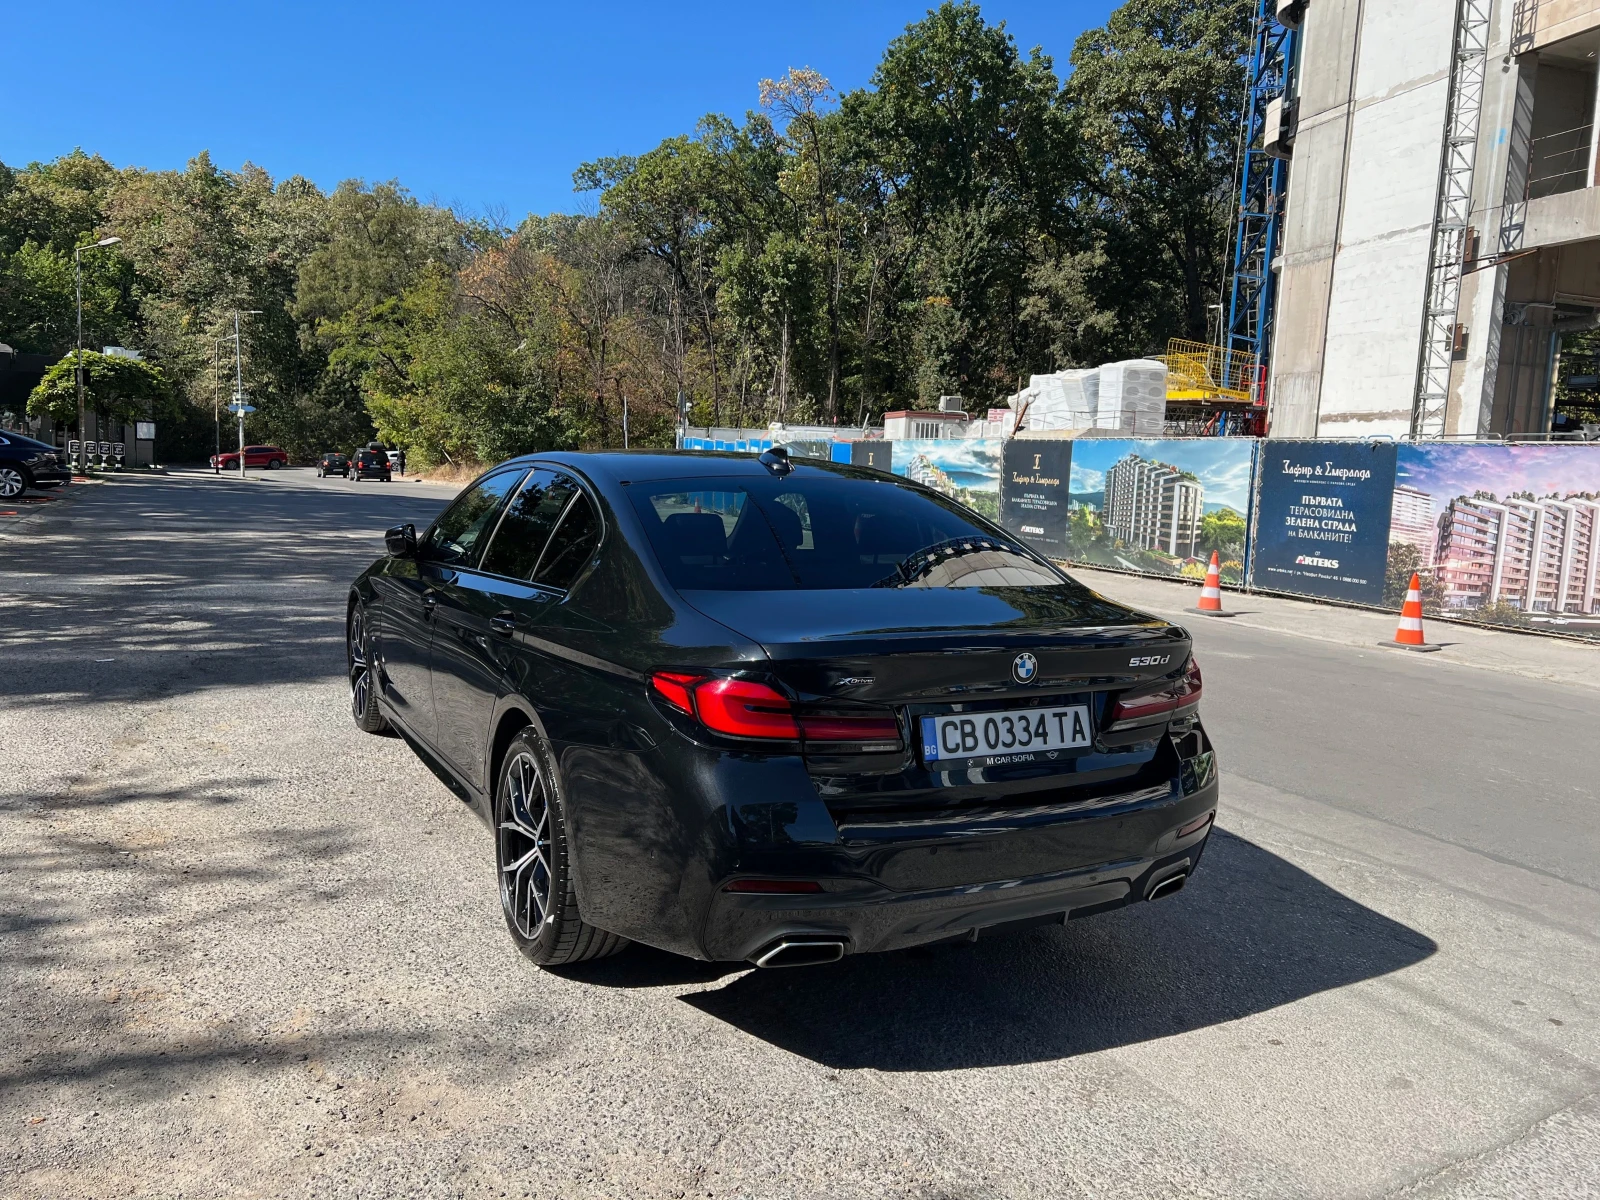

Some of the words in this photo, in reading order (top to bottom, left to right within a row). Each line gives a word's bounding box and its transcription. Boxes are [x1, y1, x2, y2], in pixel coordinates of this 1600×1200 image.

[1282, 459, 1313, 478] Зафир
[1315, 466, 1323, 476] &
[1302, 495, 1343, 508] ПЪРВАТА
[1020, 525, 1044, 534] ARTEKS
[1285, 516, 1320, 528] ЗЕЛЕНА
[1322, 520, 1357, 532] СГРАДА
[1298, 528, 1352, 543] БАЛКАНИТЕ!
[1295, 554, 1340, 568] ARTEKS
[1128, 654, 1170, 667] 530d
[942, 719, 978, 754] CB
[984, 714, 1048, 750] 0334
[1052, 710, 1086, 744] TA
[924, 744, 936, 756] BG
[986, 757, 995, 765] M
[995, 756, 1011, 764] CAR
[1012, 754, 1035, 762] SOFIA
